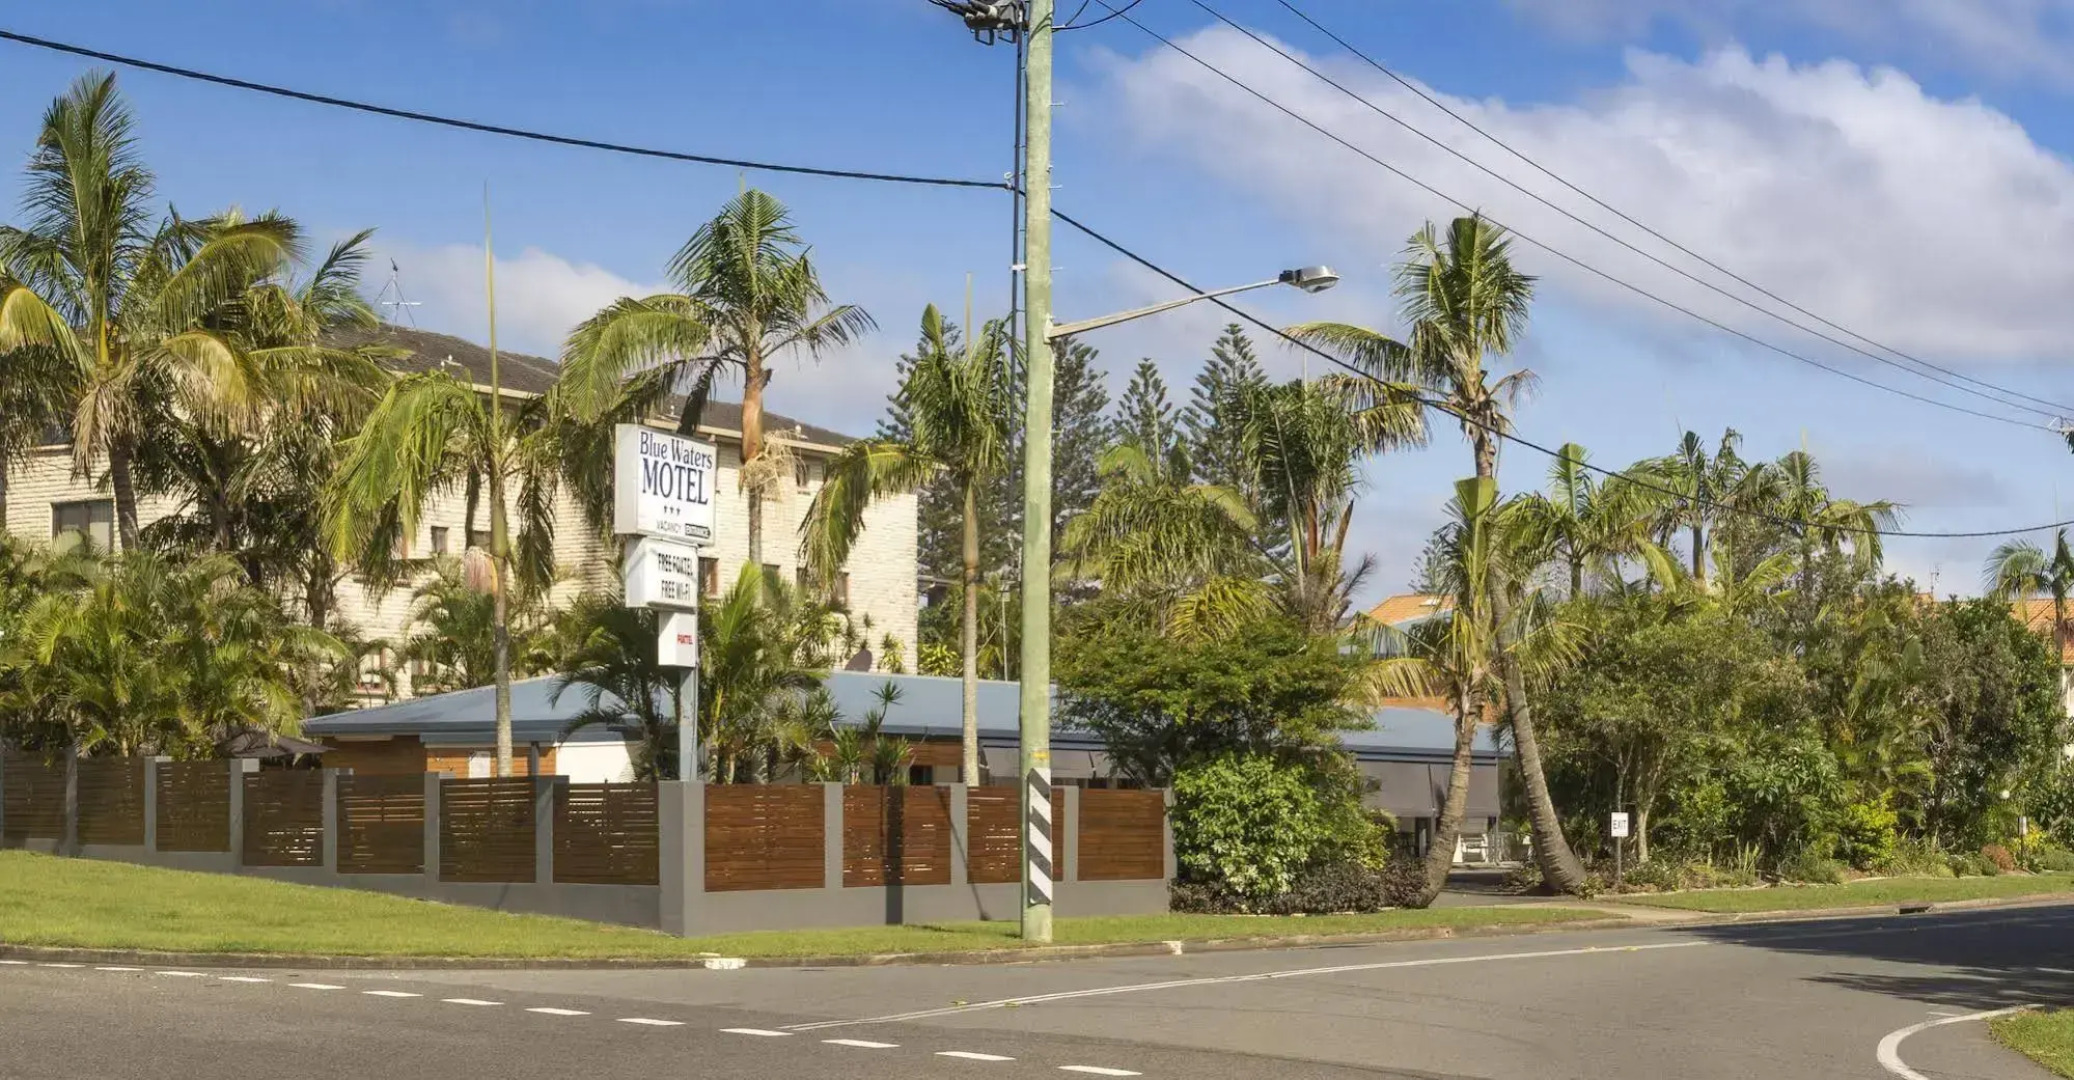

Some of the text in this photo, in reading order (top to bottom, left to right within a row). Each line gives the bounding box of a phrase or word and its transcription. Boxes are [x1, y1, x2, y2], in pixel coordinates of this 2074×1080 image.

[640, 431, 713, 470] Blue Waters
[642, 457, 709, 505] MOTEL
[658, 553, 672, 573] FREE
[662, 580, 675, 600] FREE
[1613, 819, 1627, 830] EXIT
